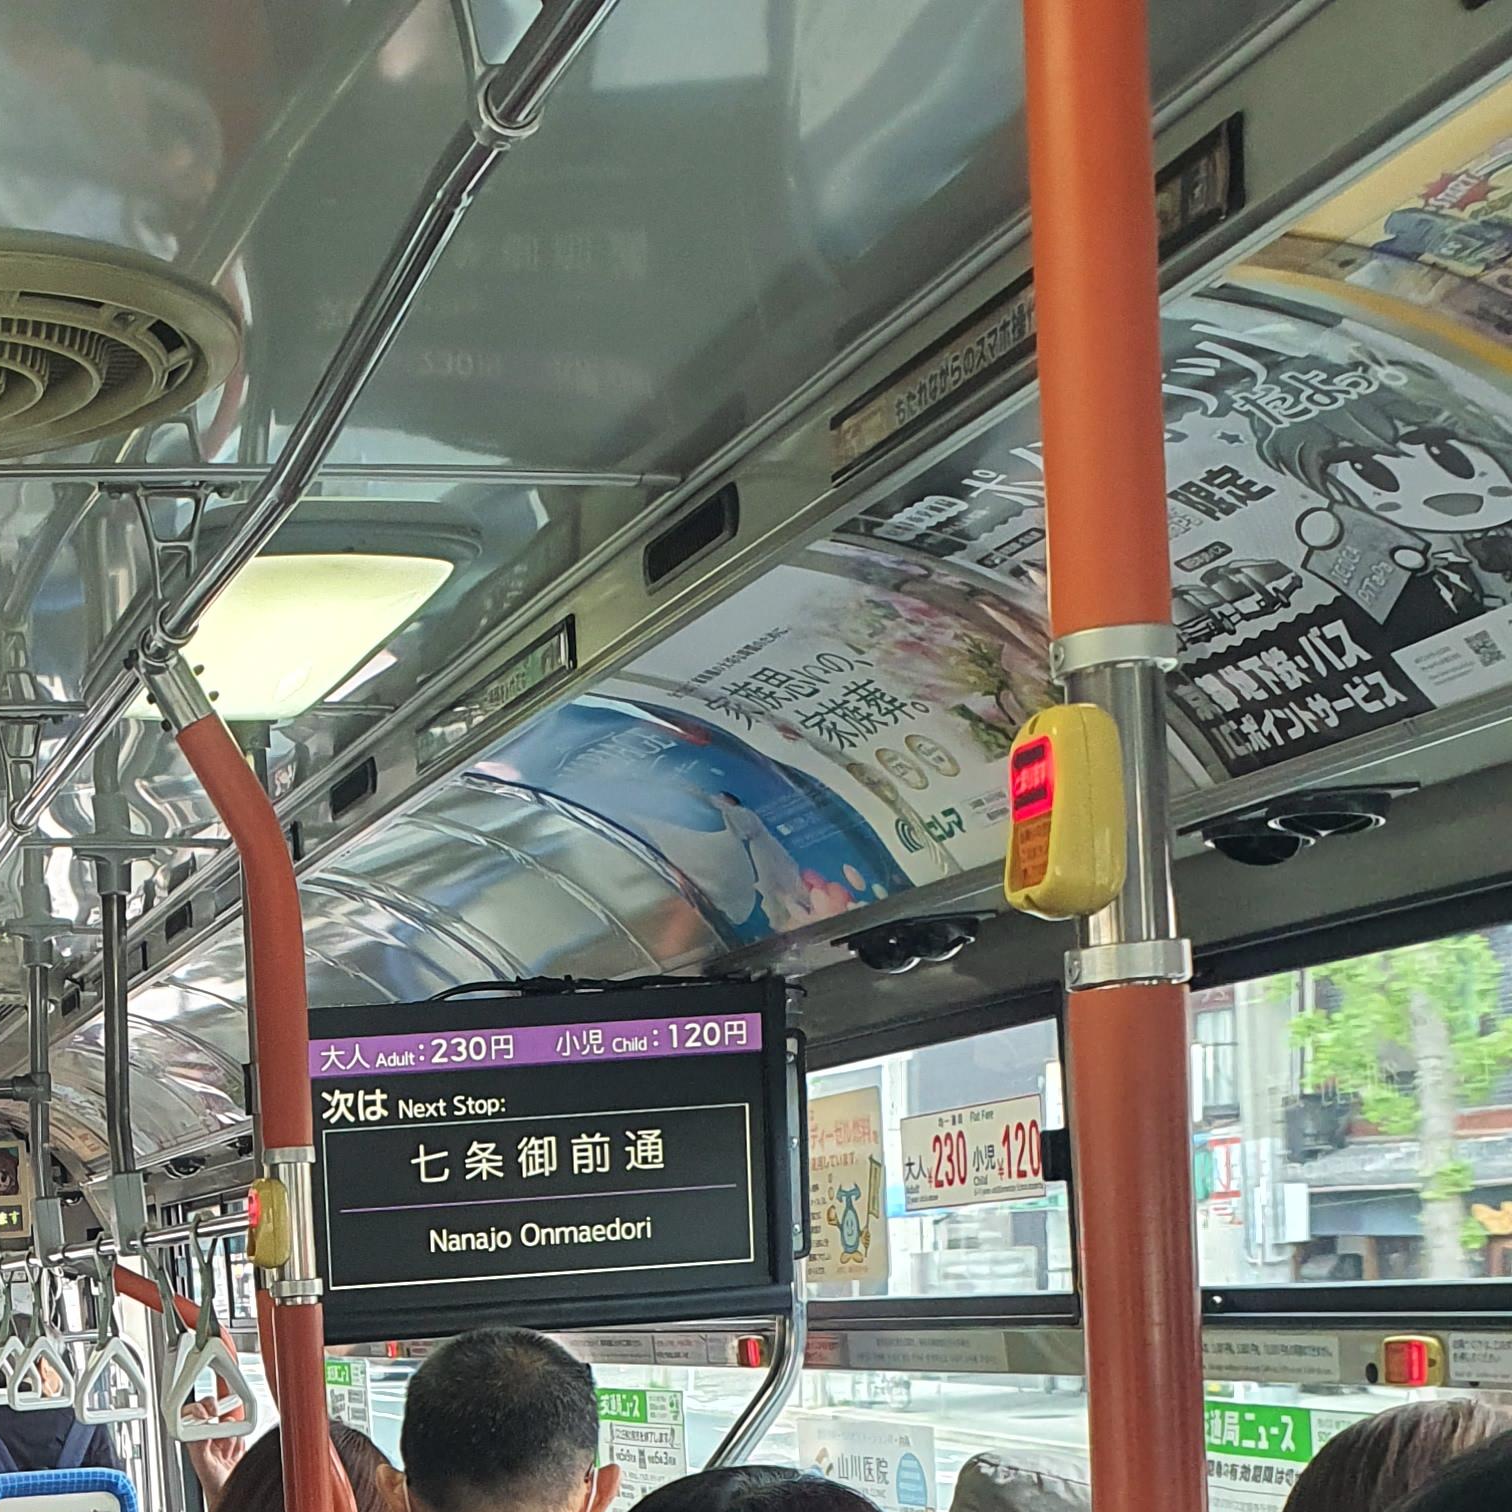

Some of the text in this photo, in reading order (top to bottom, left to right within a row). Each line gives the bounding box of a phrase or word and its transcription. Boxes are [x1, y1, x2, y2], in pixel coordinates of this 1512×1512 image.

[703, 652, 874, 730] 家族思いの、
[793, 679, 930, 749] 家族葬。
[320, 1045, 370, 1071] 大人
[430, 1034, 515, 1064] 230円
[556, 1030, 604, 1056] 小児
[668, 1020, 748, 1048] 120円
[321, 1090, 506, 1123] 次は Next Stop:
[410, 1128, 666, 1183] 七条御前通
[905, 1155, 927, 1181] 大人
[972, 1145, 995, 1171] 小児
[430, 1217, 652, 1253] Nanajo Onmaedori
[1205, 1409, 1296, 1453] 通局ニュース
